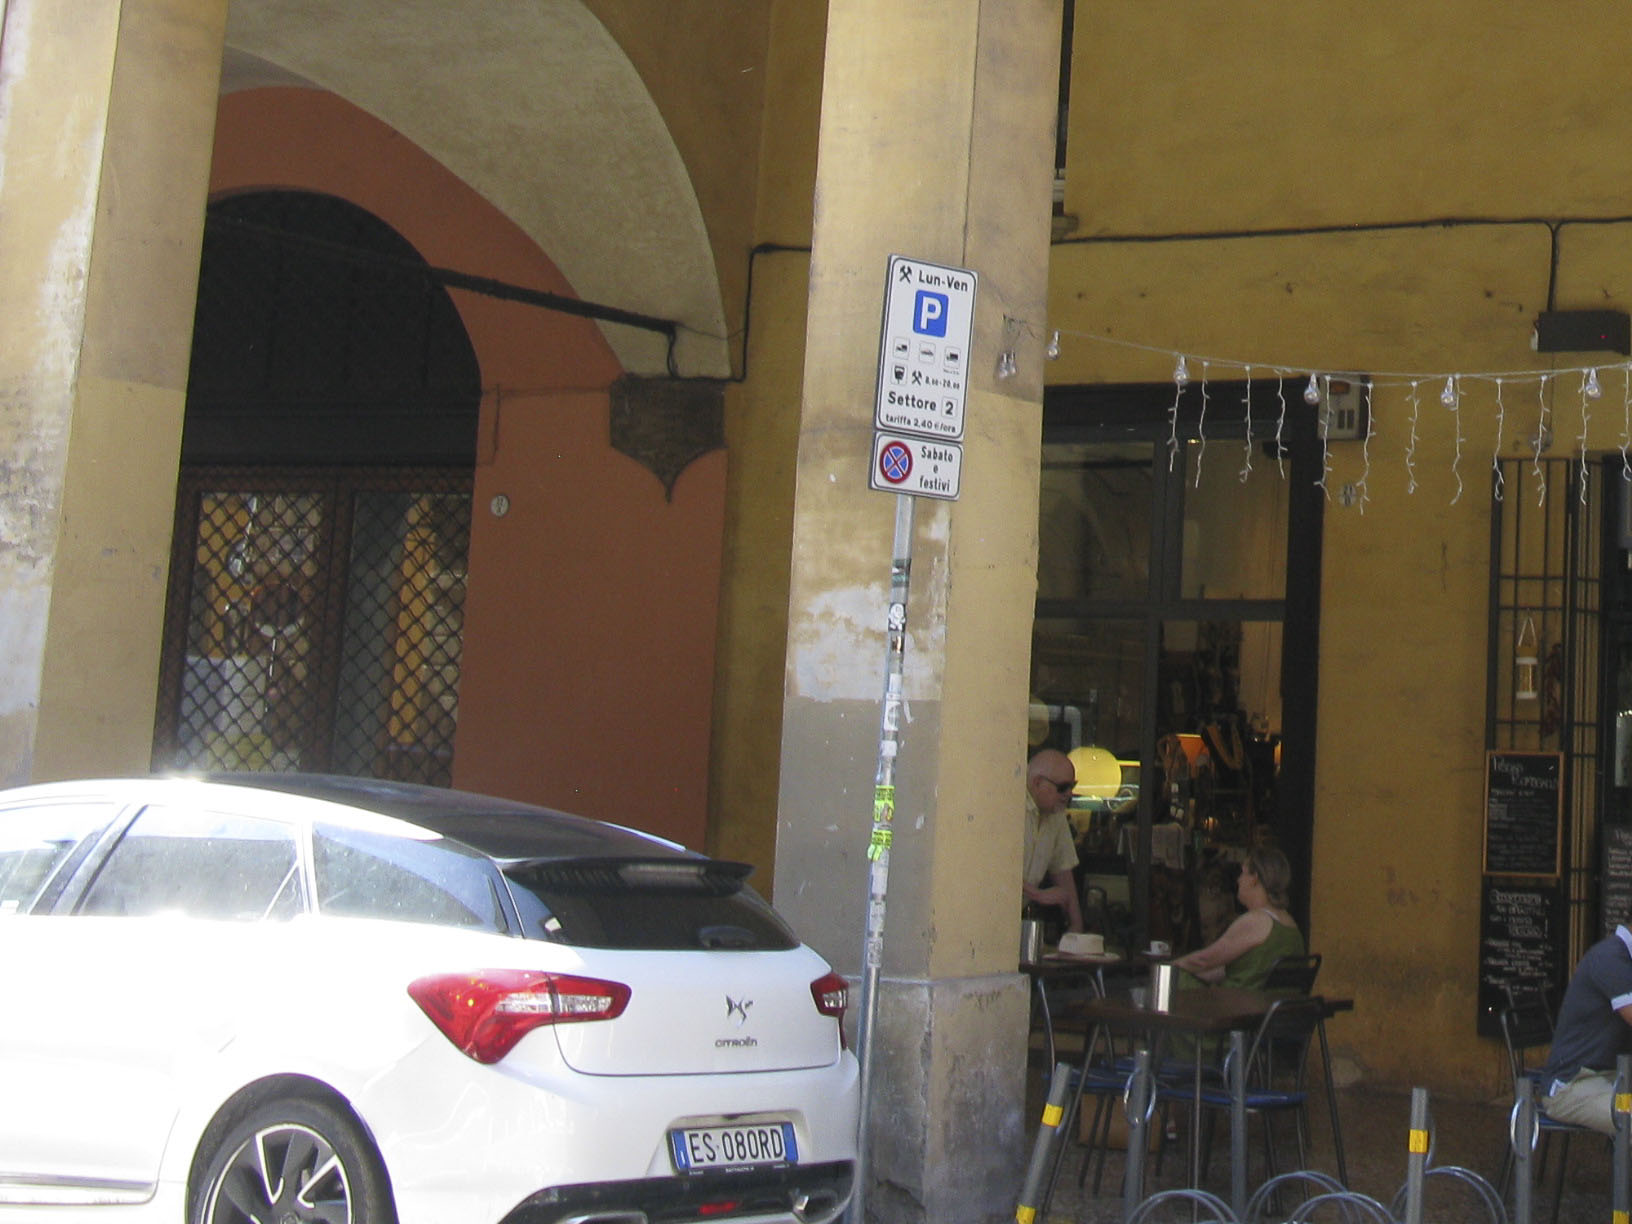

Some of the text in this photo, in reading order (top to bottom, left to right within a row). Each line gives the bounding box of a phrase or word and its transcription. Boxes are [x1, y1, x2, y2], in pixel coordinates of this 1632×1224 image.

[918, 269, 968, 292] Lun-Ven
[920, 295, 942, 330] P
[888, 391, 954, 416] Settore 2
[886, 413, 911, 426] tariffa
[921, 446, 953, 463] Sabato
[933, 464, 939, 474] e
[919, 475, 951, 492] festivi
[689, 1127, 784, 1164] ES 080RD
